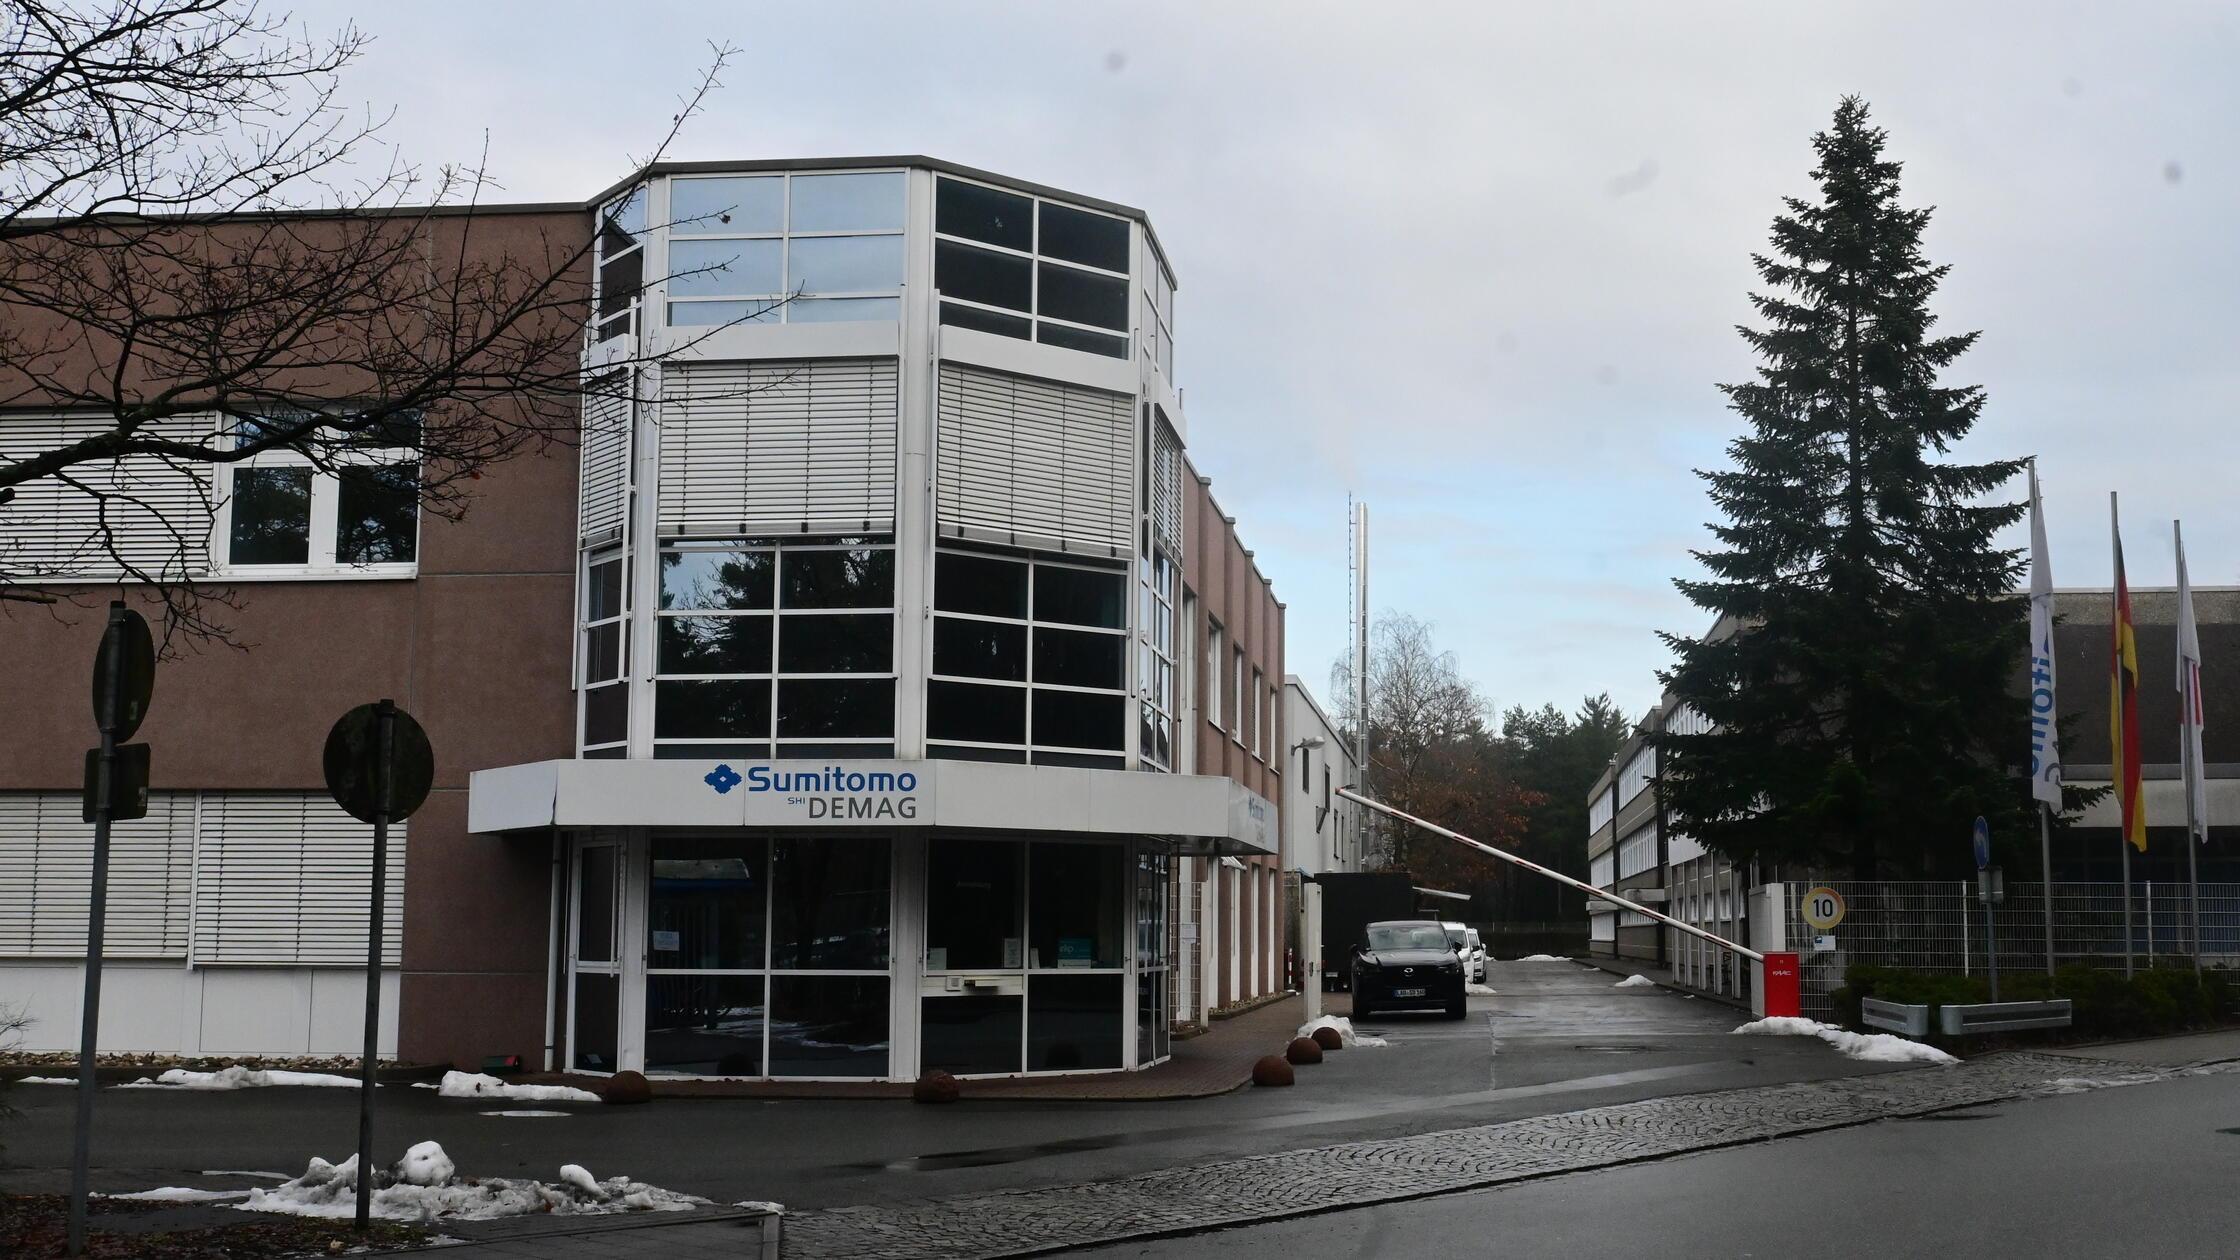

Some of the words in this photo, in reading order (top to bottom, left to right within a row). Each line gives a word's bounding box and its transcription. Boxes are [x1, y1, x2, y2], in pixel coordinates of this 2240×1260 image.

[748, 766, 917, 792] Sumitomo
[787, 797, 806, 805] SHI
[808, 797, 917, 819] DEMAG
[1813, 899, 1833, 917] 10
